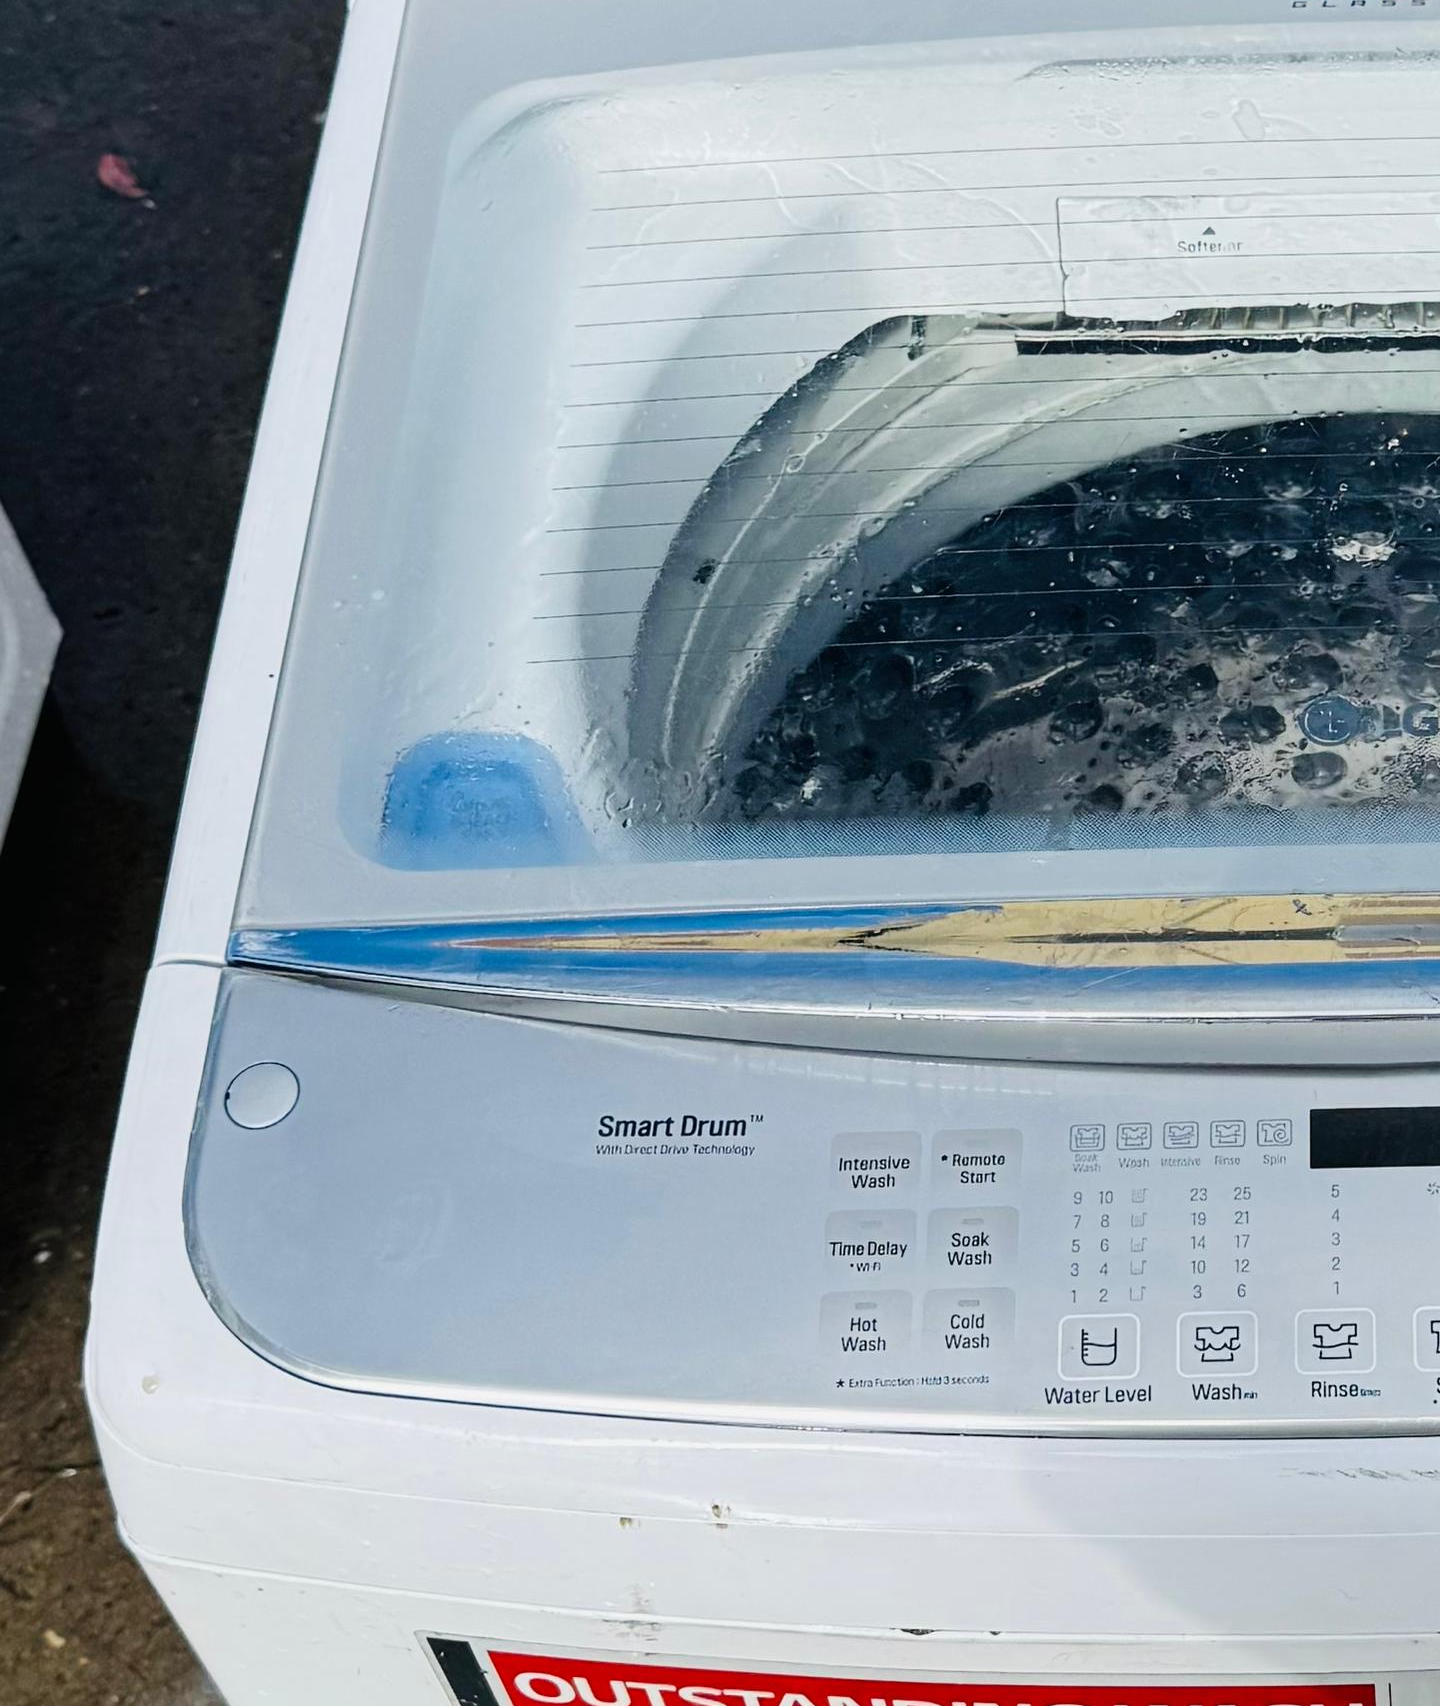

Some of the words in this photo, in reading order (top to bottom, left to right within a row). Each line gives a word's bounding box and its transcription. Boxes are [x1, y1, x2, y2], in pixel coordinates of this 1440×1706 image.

[598, 1115, 675, 1137] Smart
[838, 1155, 911, 1172] Intensive
[1263, 1153, 1287, 1167] Spin
[851, 1174, 896, 1189] Wash
[960, 1170, 997, 1184] Start
[1073, 1191, 1083, 1206] 9
[1098, 1190, 1114, 1205] 10
[1190, 1188, 1208, 1202] 23
[1233, 1186, 1252, 1201] 25
[1331, 1184, 1341, 1198] 5
[1073, 1214, 1082, 1229] 7
[1100, 1214, 1110, 1228] 8
[1191, 1212, 1207, 1226] 19
[1234, 1211, 1251, 1225] 21
[1331, 1208, 1341, 1222] 4
[951, 1231, 990, 1247] Soak
[1071, 1239, 1081, 1253] 5
[1100, 1238, 1110, 1253] 6
[1191, 1236, 1206, 1250] 14
[1234, 1234, 1250, 1249] 17
[1331, 1232, 1341, 1246] 3
[829, 1241, 865, 1257] Time
[867, 1241, 908, 1258] Delay
[947, 1250, 992, 1266] Wash
[1191, 1260, 1206, 1274] 10
[1234, 1258, 1251, 1273] 12
[1331, 1257, 1341, 1271] 2
[1070, 1263, 1080, 1277] 3
[1099, 1262, 1109, 1277] 4
[1071, 1289, 1077, 1303] 1
[1099, 1288, 1109, 1303] 2
[1193, 1285, 1202, 1299] 3
[1237, 1283, 1247, 1298] 6
[1333, 1281, 1340, 1296] 1
[850, 1317, 878, 1332] Hot
[950, 1313, 985, 1329] Cold
[841, 1336, 887, 1352] Wash
[945, 1333, 990, 1349] Wash
[849, 1378, 873, 1388] Extra
[1311, 1381, 1359, 1398] Rinse
[1045, 1386, 1100, 1405] Water
[1104, 1384, 1152, 1403] Level
[1192, 1383, 1243, 1401] Wash
